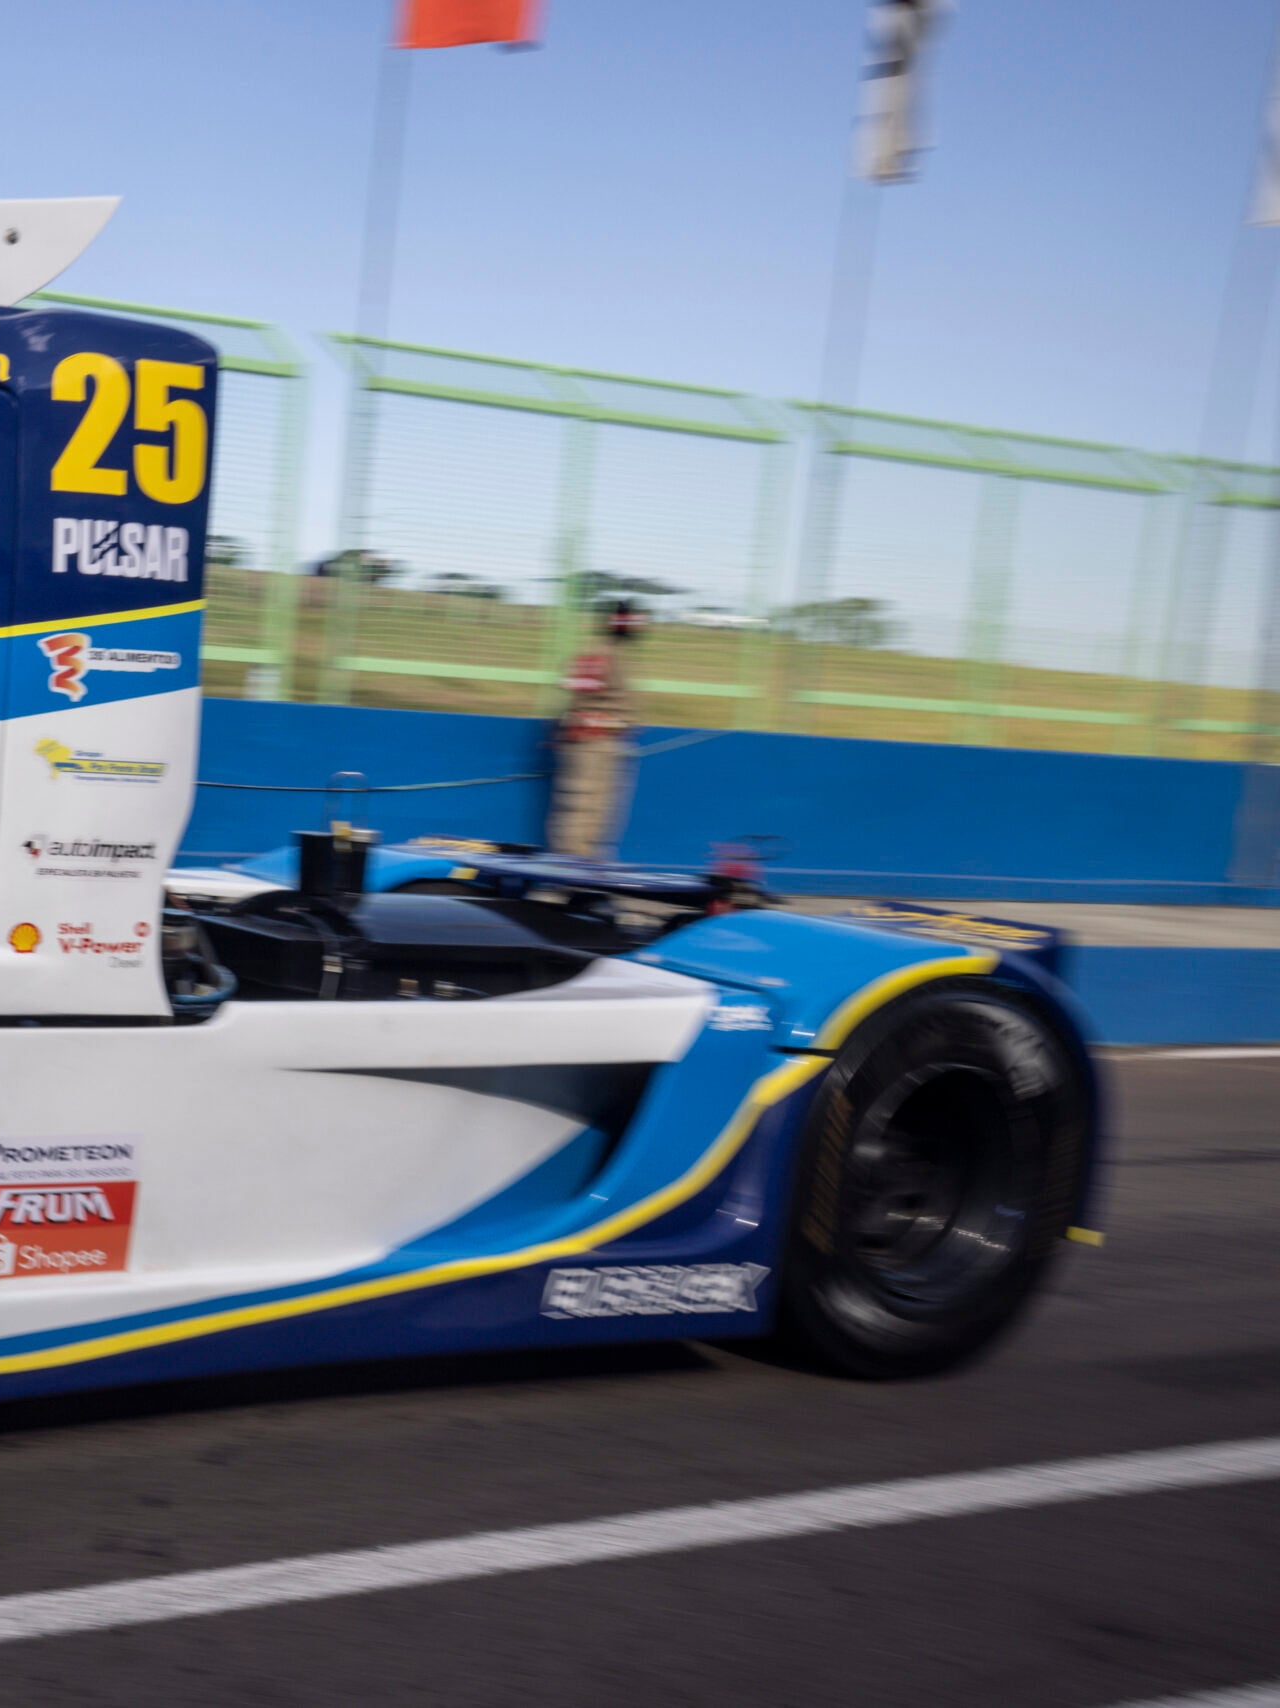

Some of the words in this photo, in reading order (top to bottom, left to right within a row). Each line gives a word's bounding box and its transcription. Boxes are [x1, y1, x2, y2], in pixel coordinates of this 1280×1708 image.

[50, 351, 208, 504] 25
[52, 517, 190, 583] PULSAR
[48, 838, 157, 861] autoimpact
[57, 923, 93, 935] Shell
[57, 938, 144, 953] V-Power
[19, 1244, 108, 1273] Shopee
